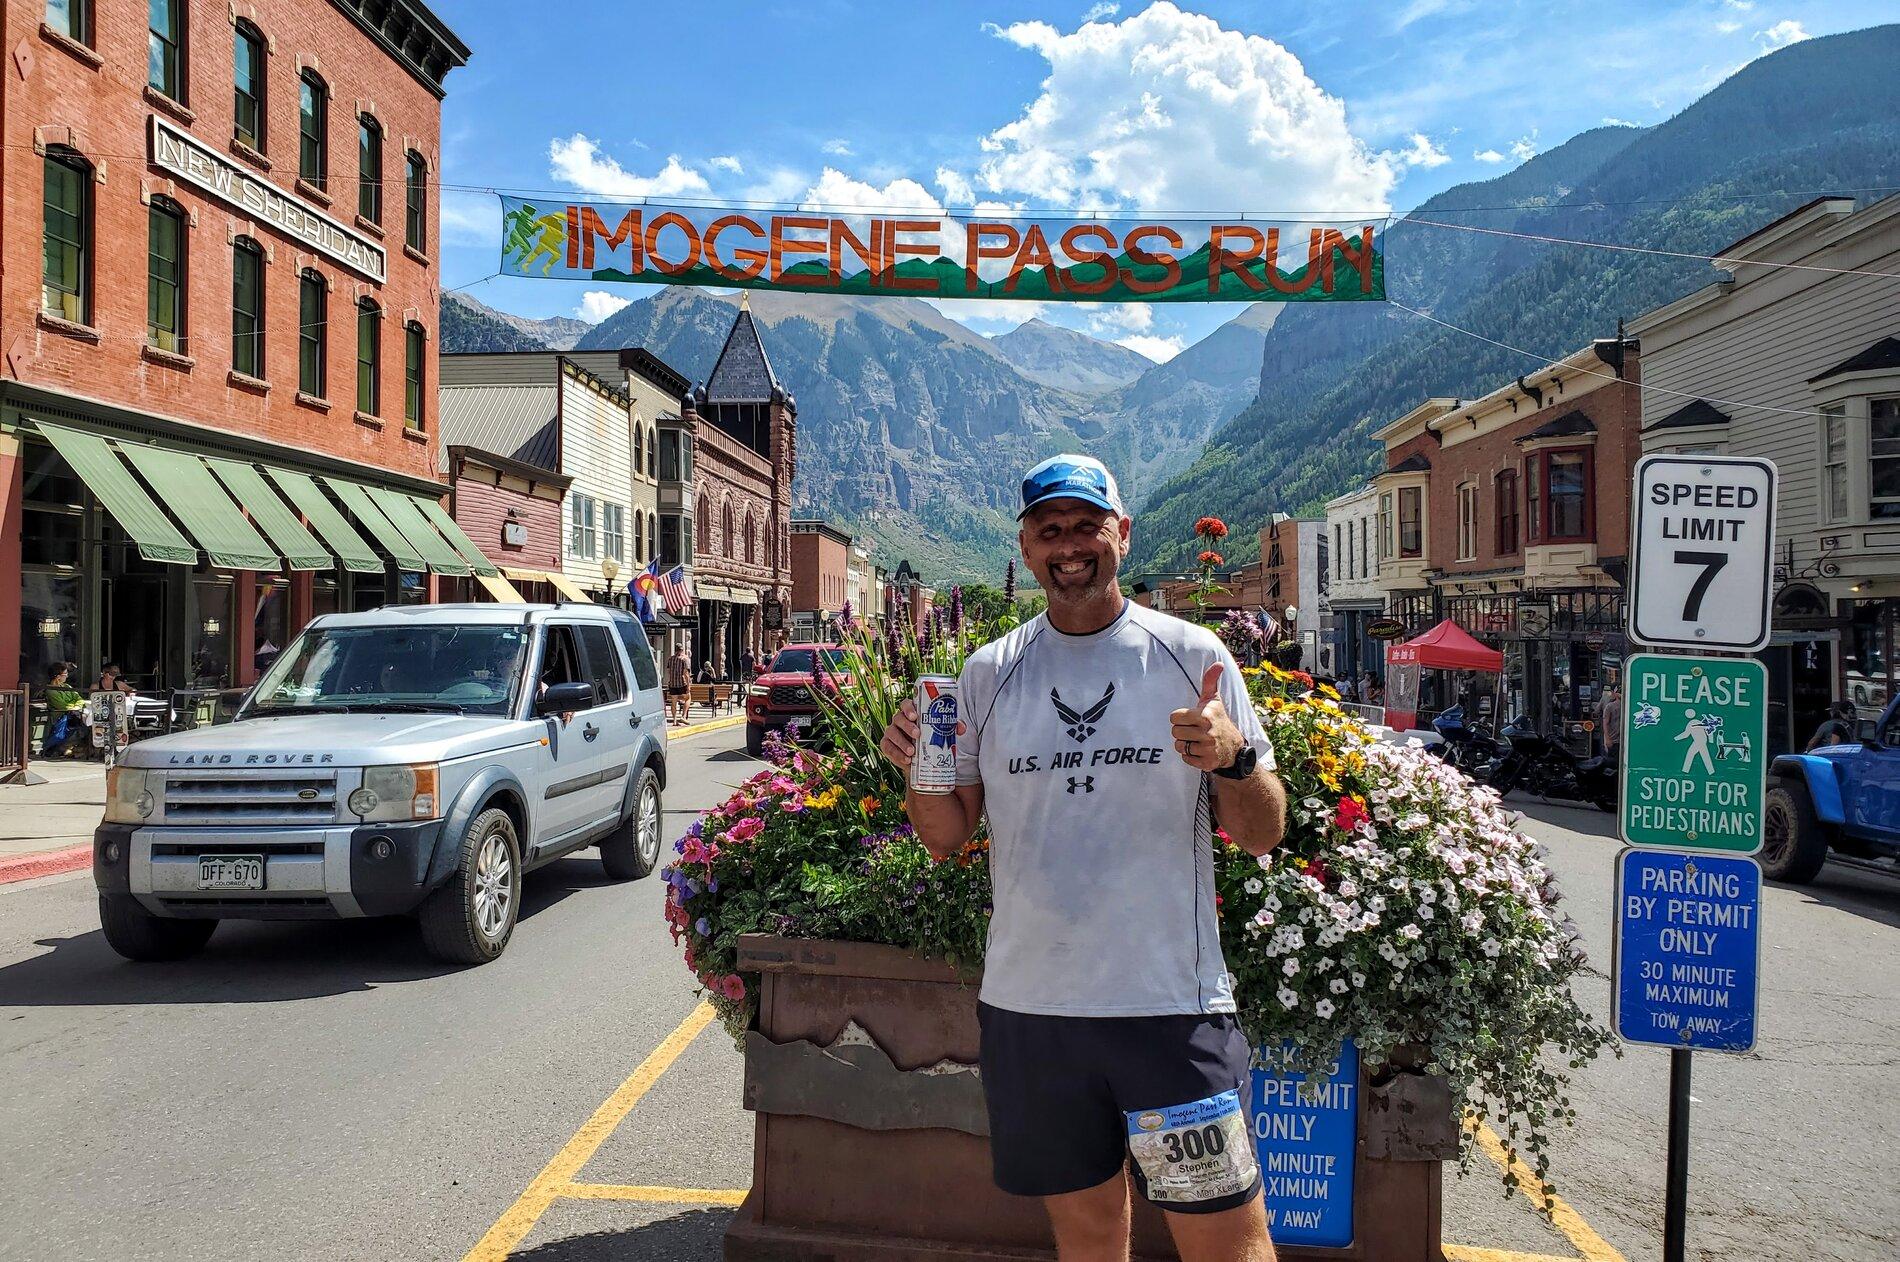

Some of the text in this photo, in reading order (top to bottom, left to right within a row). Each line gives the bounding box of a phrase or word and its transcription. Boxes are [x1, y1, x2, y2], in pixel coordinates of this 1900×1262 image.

[159, 129, 382, 276] NEW SHERIDAN
[566, 205, 1375, 293] IMOGENE PASS RUN
[1651, 483, 1758, 508] SPEED
[1662, 517, 1745, 542] LIMIT
[1674, 551, 1728, 622] 7
[1642, 673, 1750, 706] PLEASE
[923, 713, 957, 724] Blue Ribb
[169, 753, 334, 764] LAND ROVER
[937, 754, 952, 767] 24
[1008, 747, 1163, 774] U.S. AIR FORCE
[1640, 777, 1748, 806] STOP FOR
[1631, 805, 1755, 836] PEDESTRIANS
[1641, 867, 1740, 899] PARKING
[1627, 896, 1752, 929] BY PERMIT
[1660, 928, 1718, 956] ONLY
[1640, 961, 1736, 987] 30 MINUTE
[1646, 983, 1729, 1008] MAXIMUM
[1651, 1012, 1722, 1034] TOW AWAY
[1168, 1109, 1198, 1121] Imogene
[1200, 1102, 1218, 1114] Pass
[1255, 1111, 1317, 1141] ONLY
[1162, 1124, 1224, 1163] 300
[1179, 1159, 1219, 1173] Stephen
[1268, 1152, 1335, 1176] MINUTE
[1152, 1190, 1168, 1198] 300
[1262, 1176, 1328, 1200] XIMUM
[1283, 1211, 1321, 1229] AWAY
